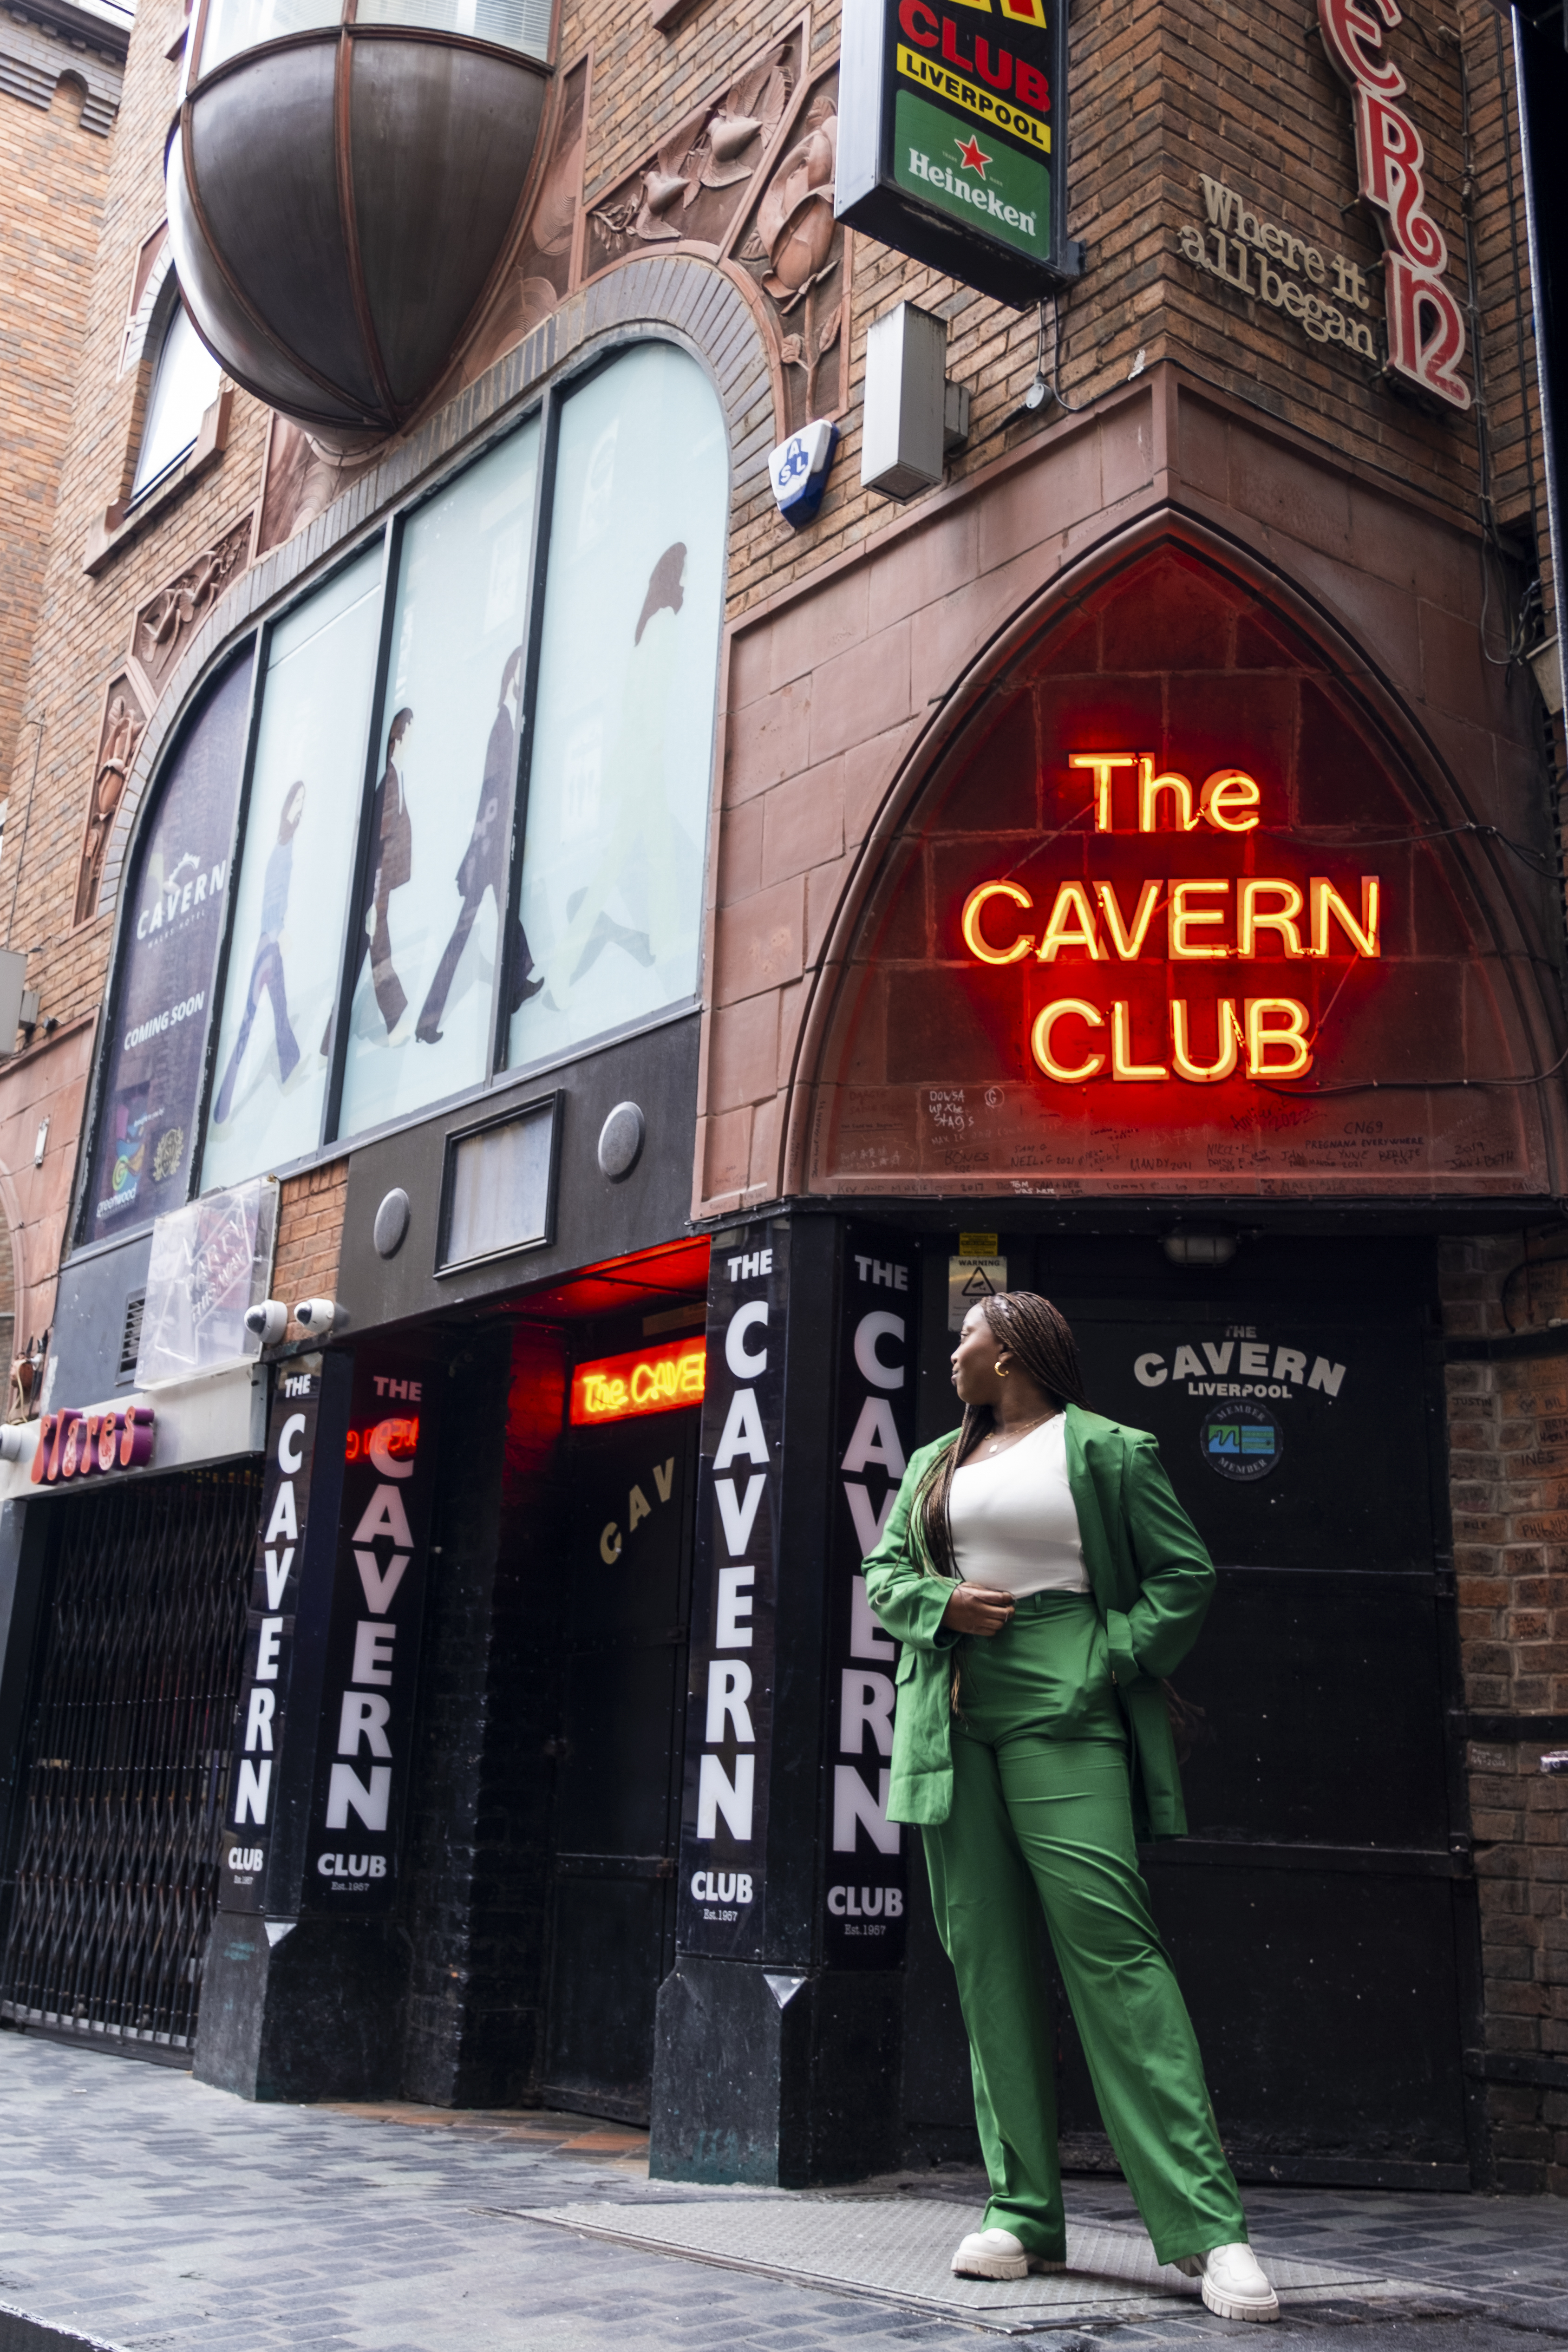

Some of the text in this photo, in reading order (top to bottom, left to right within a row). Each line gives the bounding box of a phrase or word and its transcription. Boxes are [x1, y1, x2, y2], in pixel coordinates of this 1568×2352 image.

[898, 0, 1051, 112] CLUB
[907, 53, 1044, 145] LIVERPOOL
[908, 148, 1036, 236] Heineken
[1198, 173, 1370, 310] Where it
[1178, 225, 1378, 361] all began
[1068, 752, 1261, 833] The
[137, 860, 226, 940] CAVERN
[179, 909, 205, 929] HOTEL
[961, 875, 1380, 964] CAVERN
[124, 991, 205, 1051] COMING SOON
[1031, 998, 1313, 1083] CLUB
[1361, 1137, 1425, 1147] EVERYWHERE
[727, 1248, 772, 1282] THE
[854, 1254, 908, 1291] THE
[1225, 1326, 1257, 1338] THE
[285, 1374, 310, 1397] THE
[1134, 1341, 1346, 1397] CAVERN
[373, 1376, 422, 1402] THE
[1188, 1382, 1293, 1398] LIVERPOOL
[1452, 1397, 1492, 1407] JUSTIN
[1216, 1405, 1265, 1422] MEMBER
[1218, 1457, 1267, 1474] MEMBER
[696, 1300, 770, 1841] CAVERN
[234, 1413, 306, 1824] CAVERN
[325, 1418, 415, 1830] CAVERN
[228, 1847, 263, 1872] CLUB
[318, 1853, 386, 1878] CLUB
[690, 1870, 753, 1903] CLUB
[827, 1885, 903, 1918] CLUB
